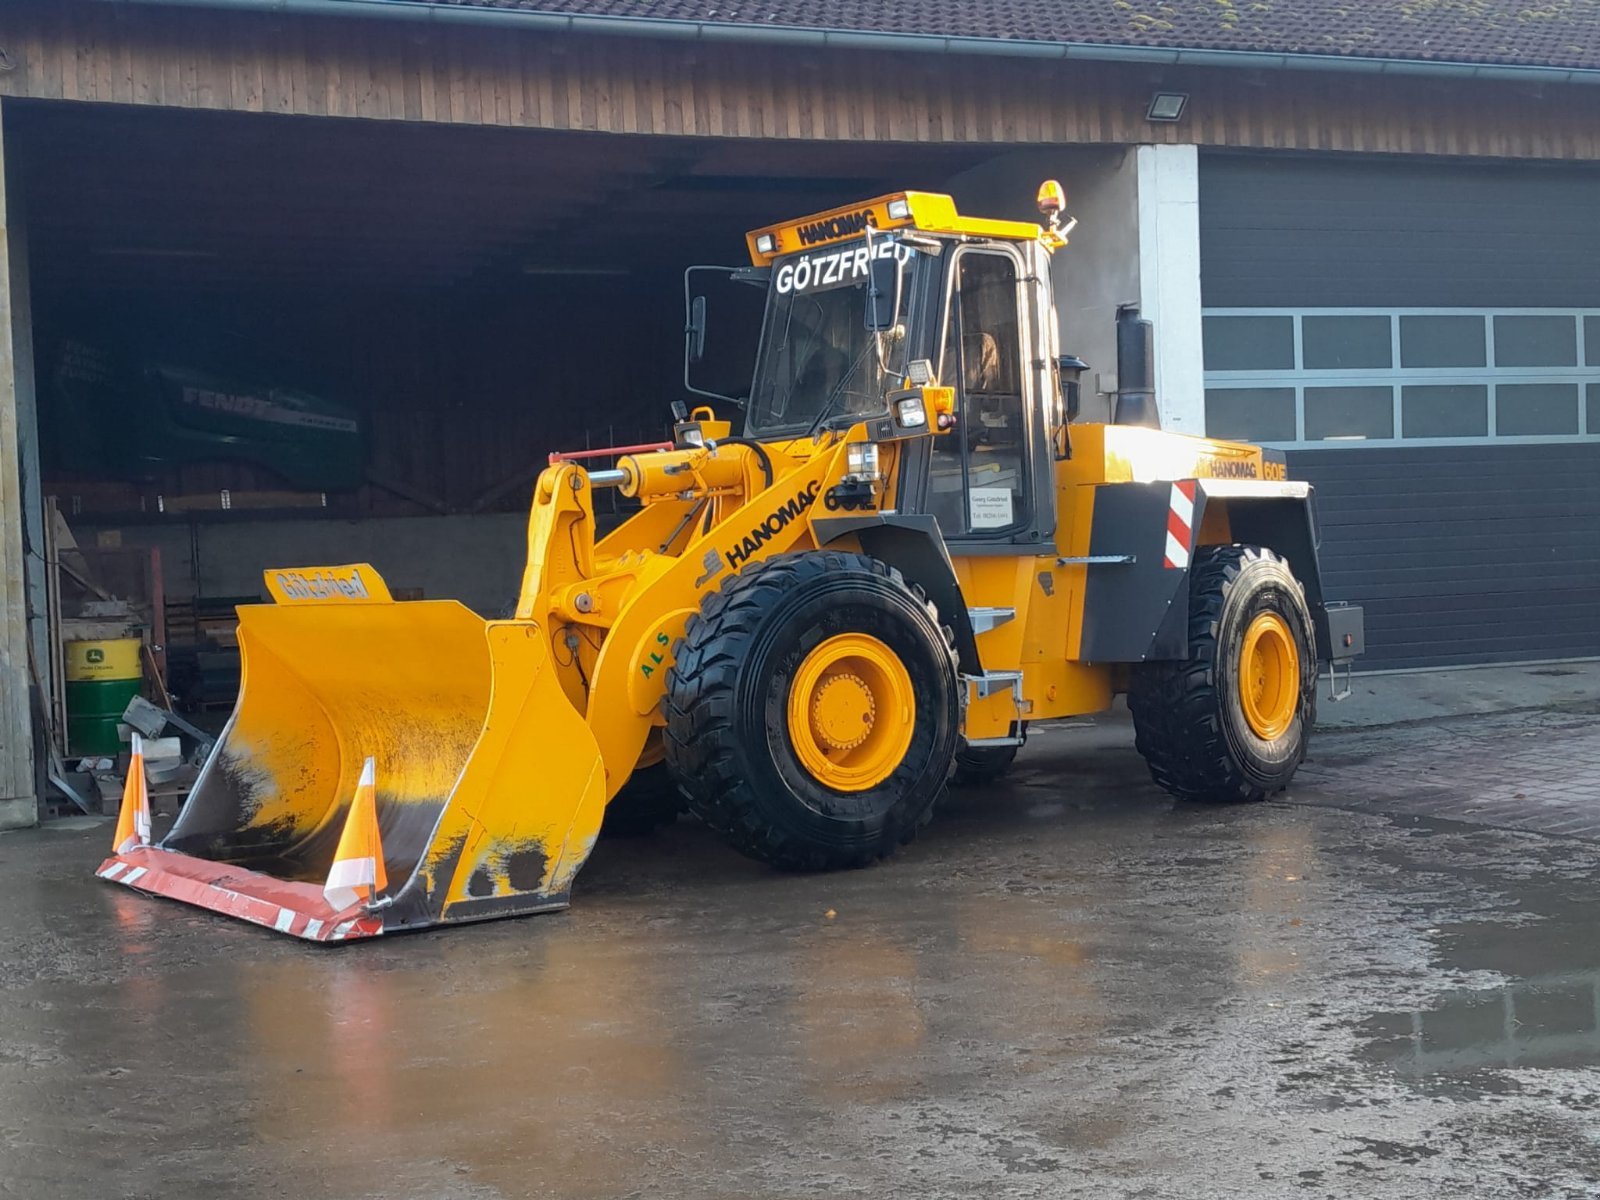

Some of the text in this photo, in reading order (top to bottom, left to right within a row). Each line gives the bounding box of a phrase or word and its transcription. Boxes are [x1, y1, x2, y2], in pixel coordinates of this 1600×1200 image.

[797, 209, 878, 246] HANOMAG
[776, 241, 911, 294] GÖTZFRIED
[1210, 460, 1287, 480] HANOMAG 60E
[725, 480, 822, 569] HANOMAG
